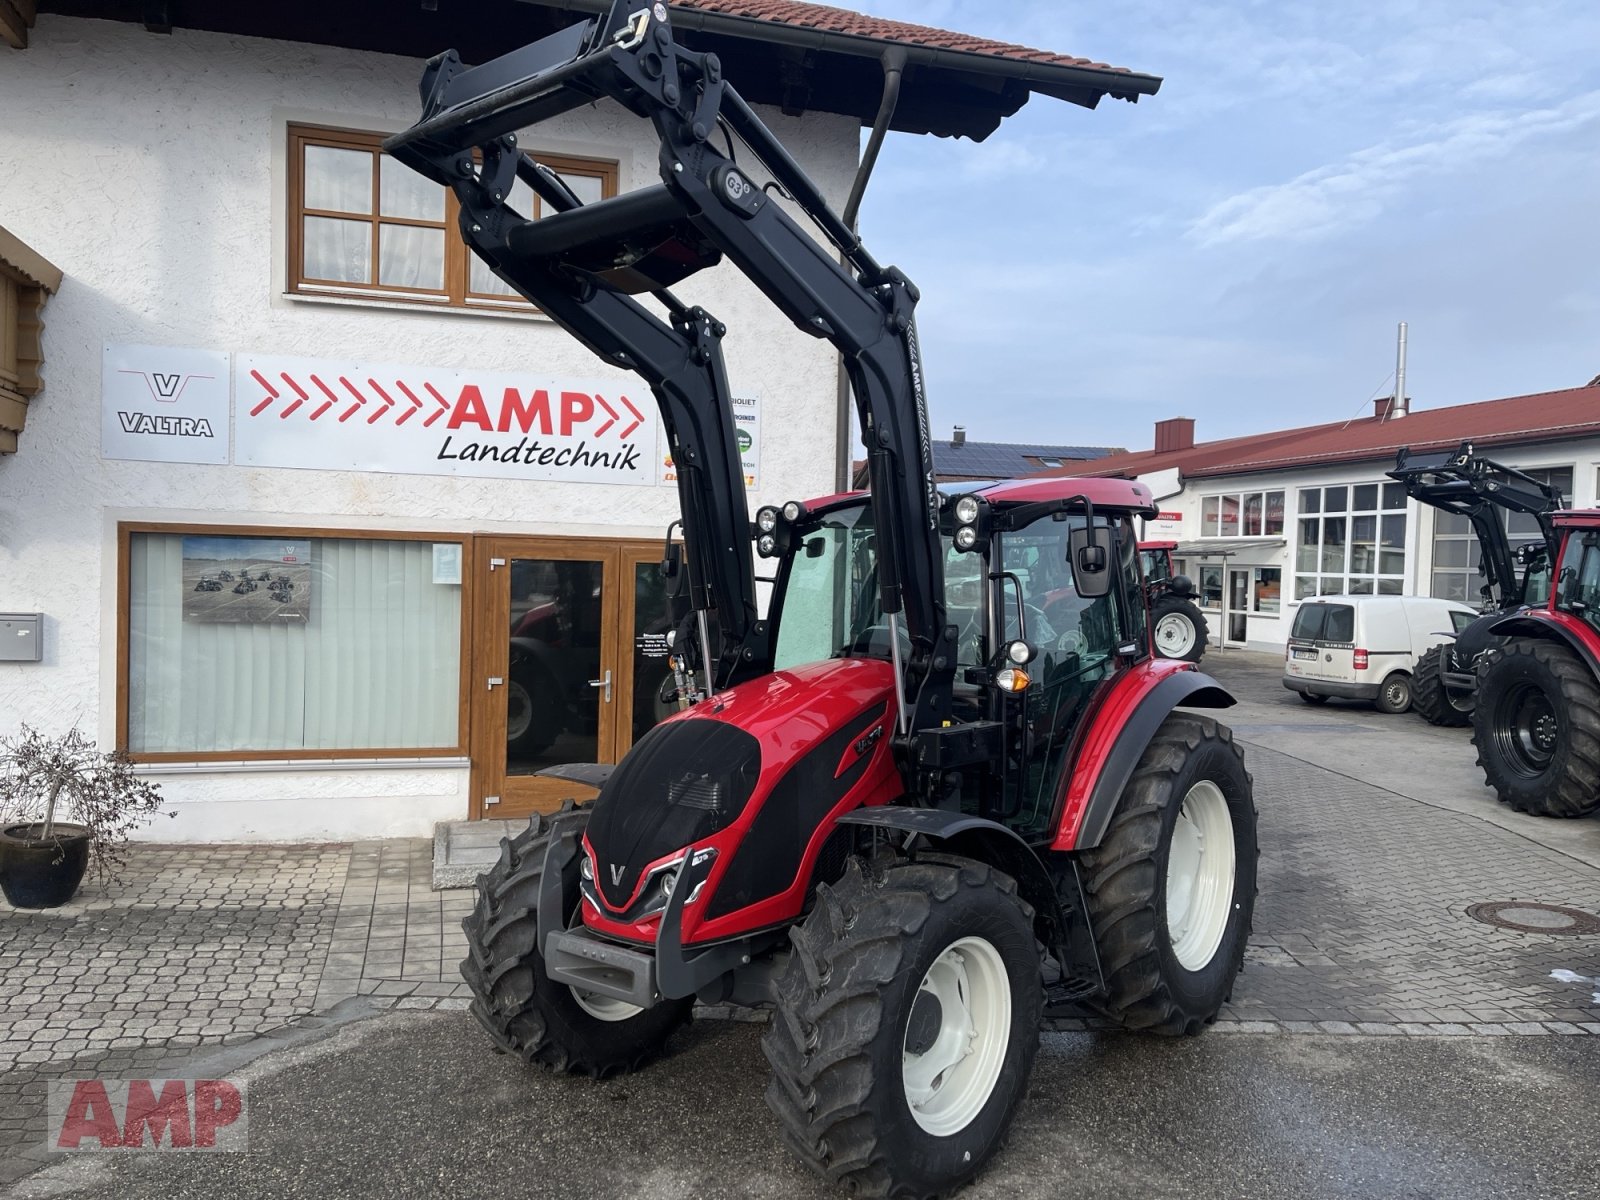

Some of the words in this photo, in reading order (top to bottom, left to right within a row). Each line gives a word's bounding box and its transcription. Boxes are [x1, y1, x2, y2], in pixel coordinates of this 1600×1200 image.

[153, 373, 180, 397] V
[911, 361, 921, 392] AMP
[117, 411, 214, 438] VALTRA
[446, 384, 595, 437] AMP
[437, 435, 641, 470] Landtechnik
